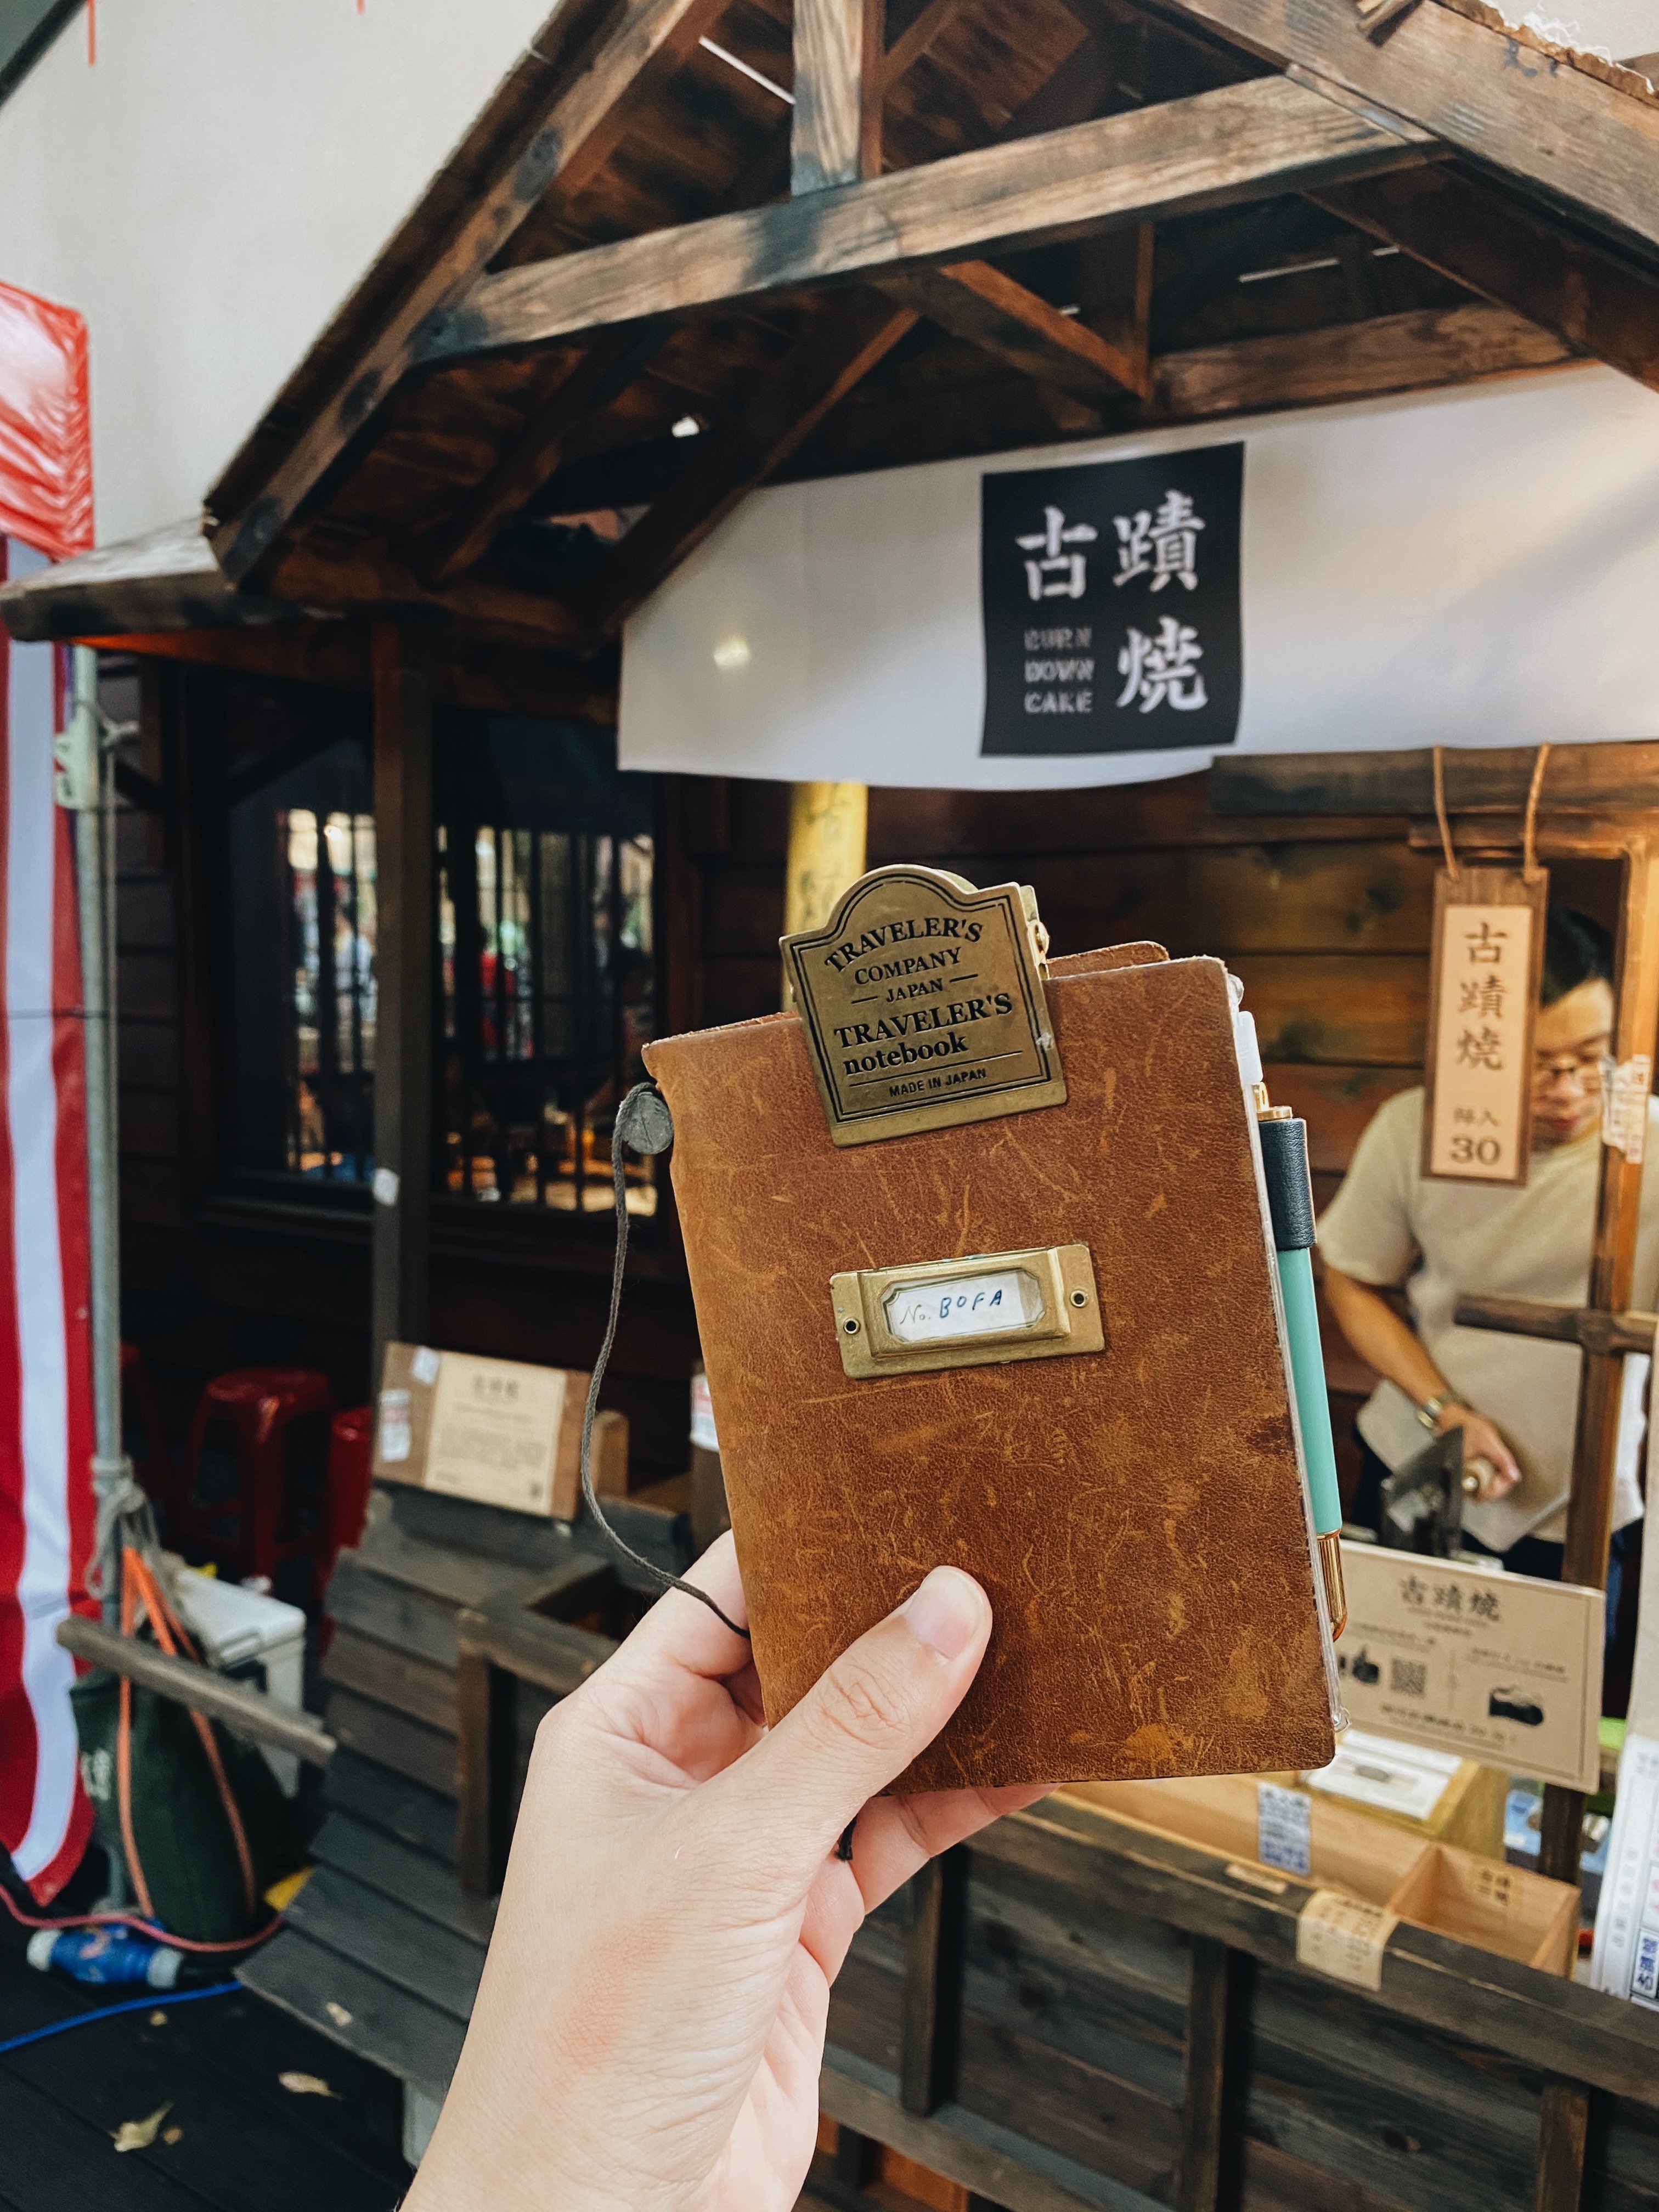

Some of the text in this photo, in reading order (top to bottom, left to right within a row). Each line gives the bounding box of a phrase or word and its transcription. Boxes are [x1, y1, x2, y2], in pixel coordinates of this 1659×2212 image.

[1014, 488, 1206, 601] 古蹟
[1024, 659, 1095, 682] DOWN
[1115, 614, 1208, 713] 燒
[1024, 691, 1093, 713] CAKE
[825, 917, 984, 973] TRAVELER'S
[854, 946, 962, 985] COMPANY
[885, 978, 944, 1003] JAPAN
[1457, 921, 1508, 1071] 古蹟燒
[833, 992, 1013, 1049] TRAVELER'S
[843, 1031, 969, 1076] notebook
[889, 1068, 987, 1097] MADE IN JAPAN
[1450, 1135, 1502, 1166] 30
[899, 1304, 932, 1325] No.
